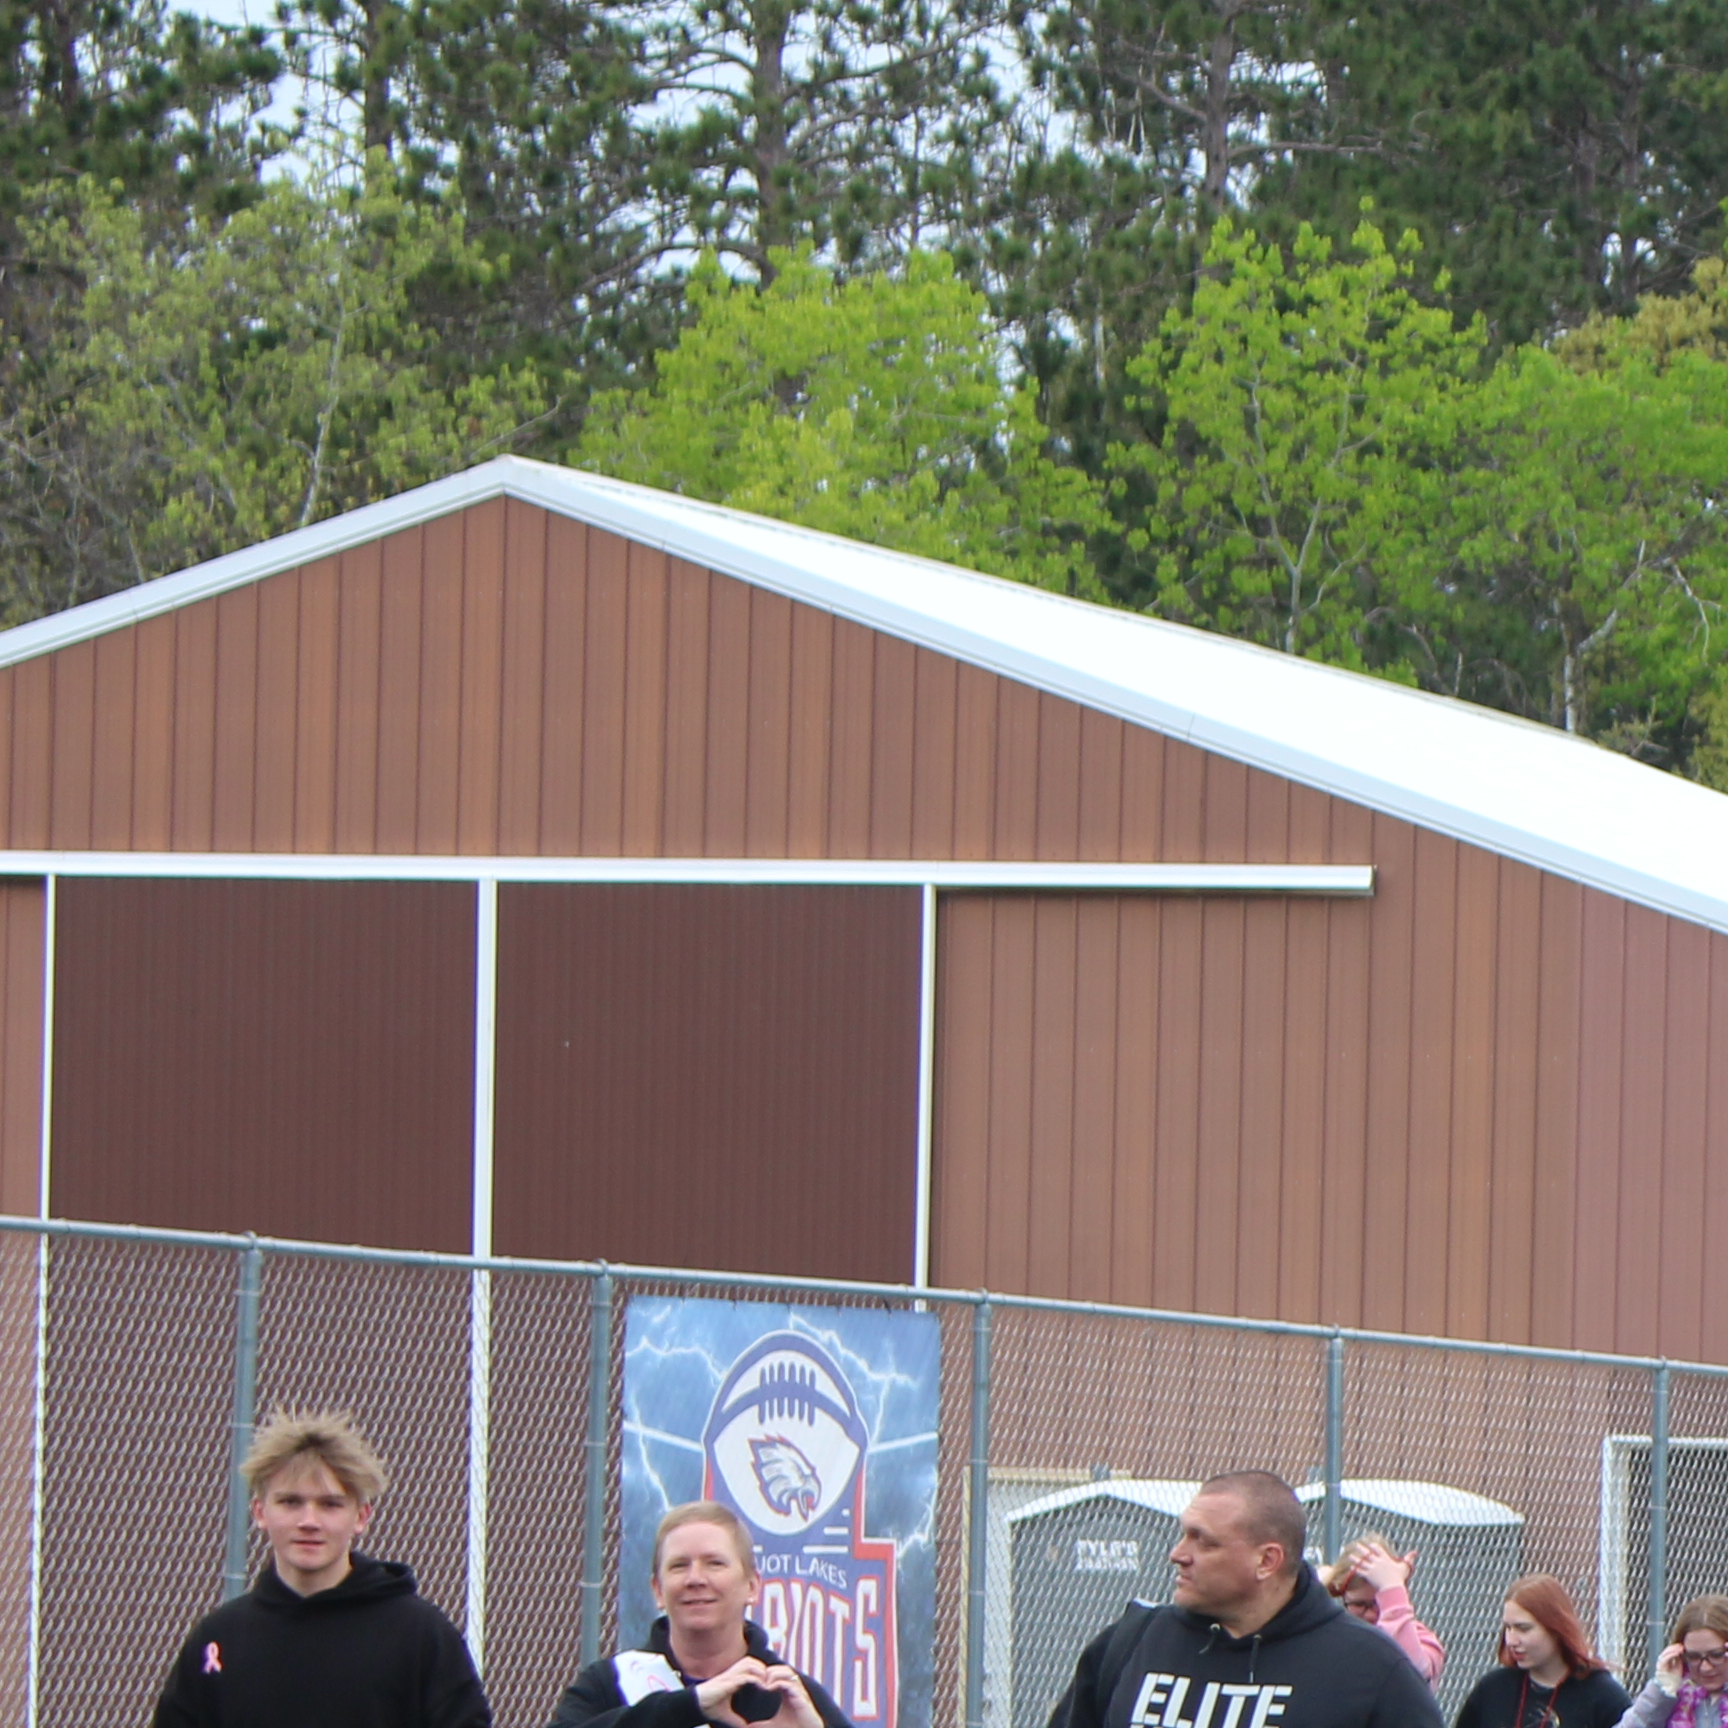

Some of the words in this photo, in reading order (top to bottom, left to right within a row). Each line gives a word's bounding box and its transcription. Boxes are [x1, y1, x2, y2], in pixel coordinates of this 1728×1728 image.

[755, 1554, 792, 1575] UOT
[795, 1557, 847, 1589] LAKES
[762, 1577, 878, 1719] RIOTS
